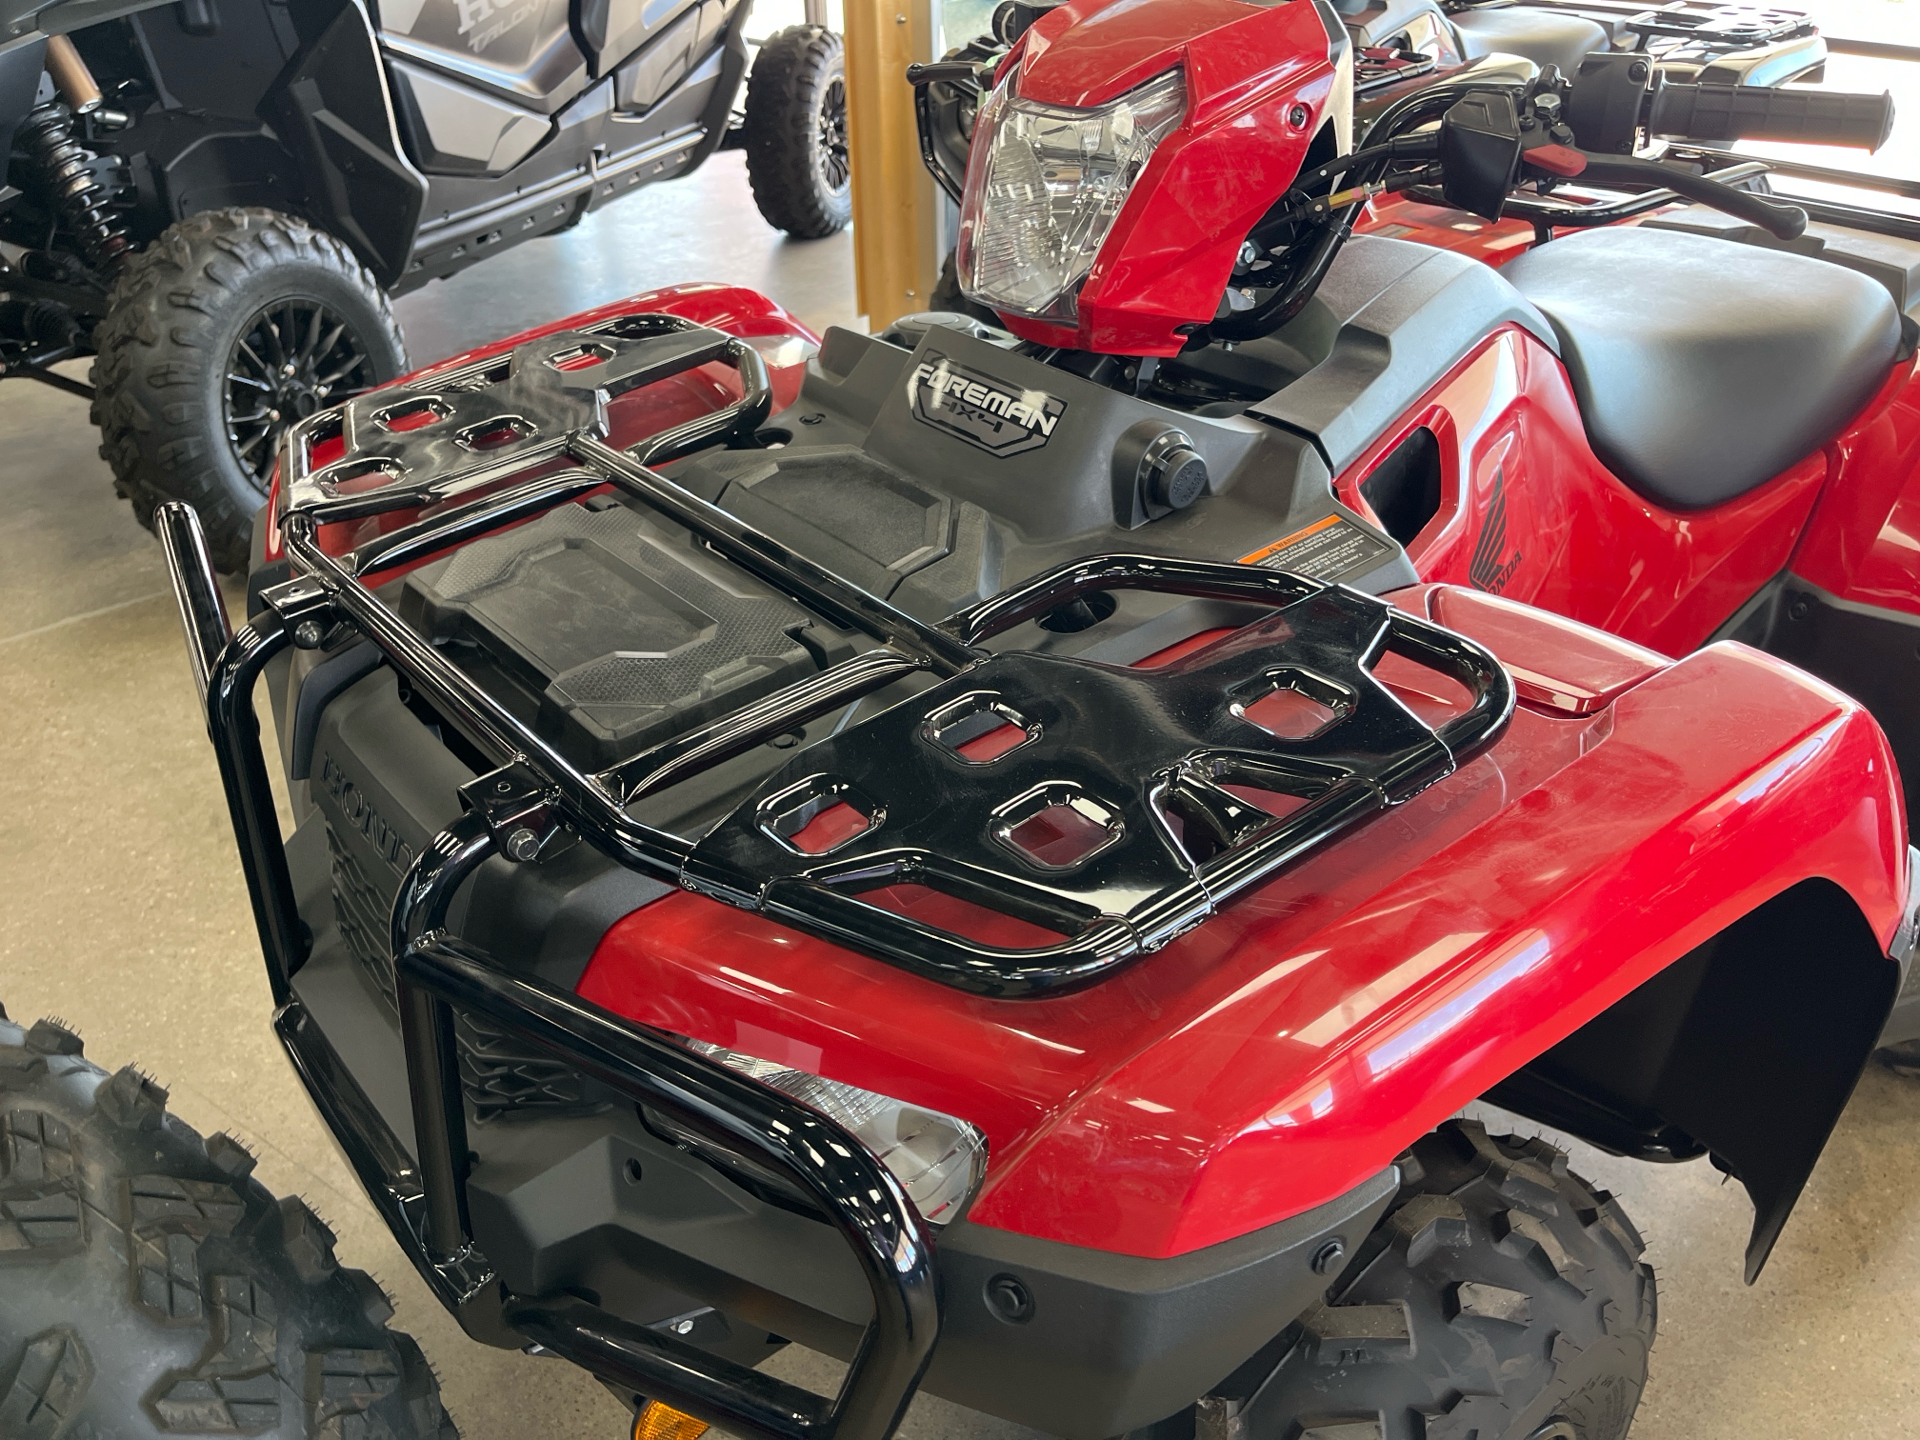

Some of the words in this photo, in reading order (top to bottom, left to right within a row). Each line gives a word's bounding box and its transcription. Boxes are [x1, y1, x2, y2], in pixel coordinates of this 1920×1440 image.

[911, 362, 1058, 436] FOREMAN
[1276, 532, 1308, 548] WARNING
[321, 751, 414, 880] HOND
